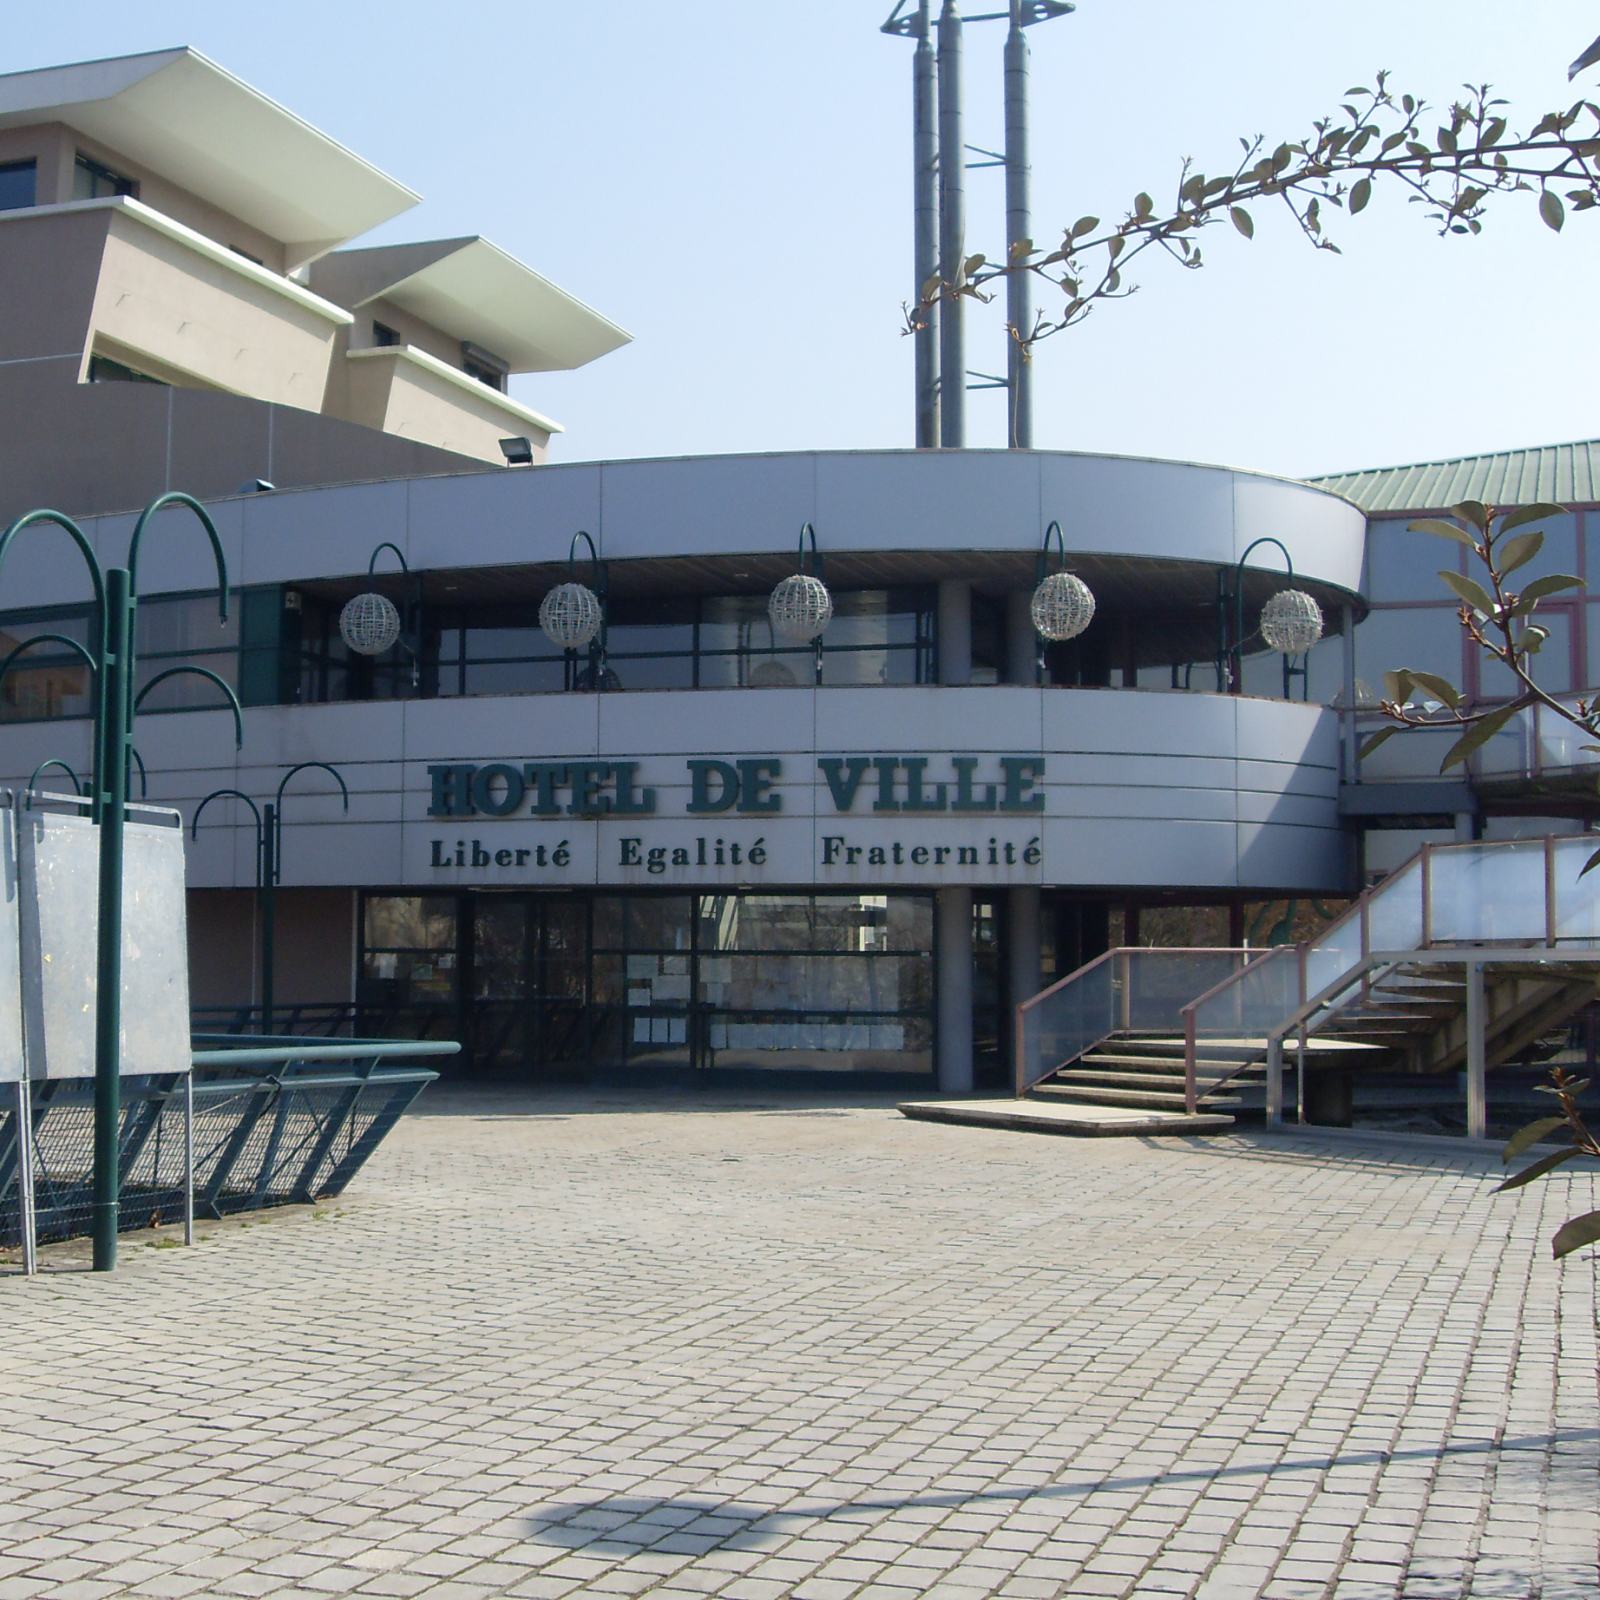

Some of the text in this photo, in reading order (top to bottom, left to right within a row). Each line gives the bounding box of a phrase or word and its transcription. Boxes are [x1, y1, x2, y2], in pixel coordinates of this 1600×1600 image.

[427, 757, 1045, 816] HOTEL DE VILLE
[430, 836, 1042, 873] Liberté Egalité Fraternité
